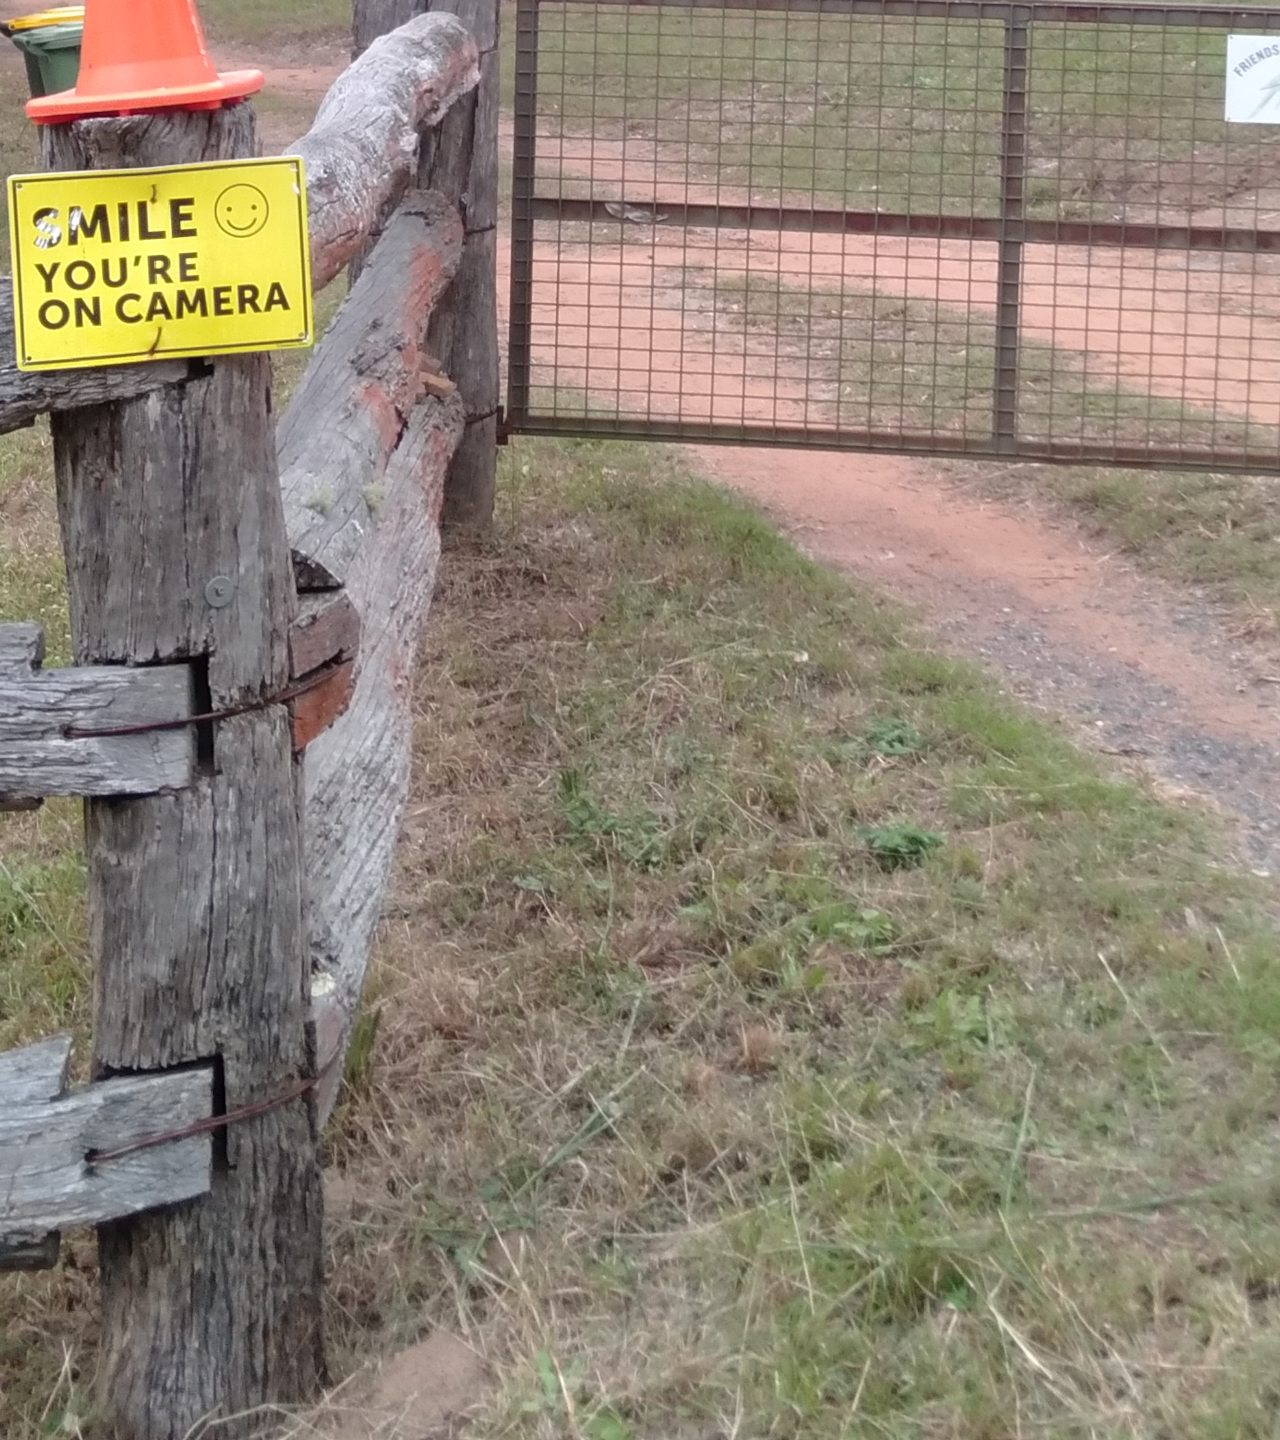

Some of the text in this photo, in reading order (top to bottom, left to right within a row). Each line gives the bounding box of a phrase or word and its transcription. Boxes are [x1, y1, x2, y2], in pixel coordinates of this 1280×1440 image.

[1233, 44, 1280, 77] FRIENDS
[32, 197, 198, 249] SMILE
[35, 252, 200, 293] YOU'RE
[38, 281, 291, 330] ON CAMERA
